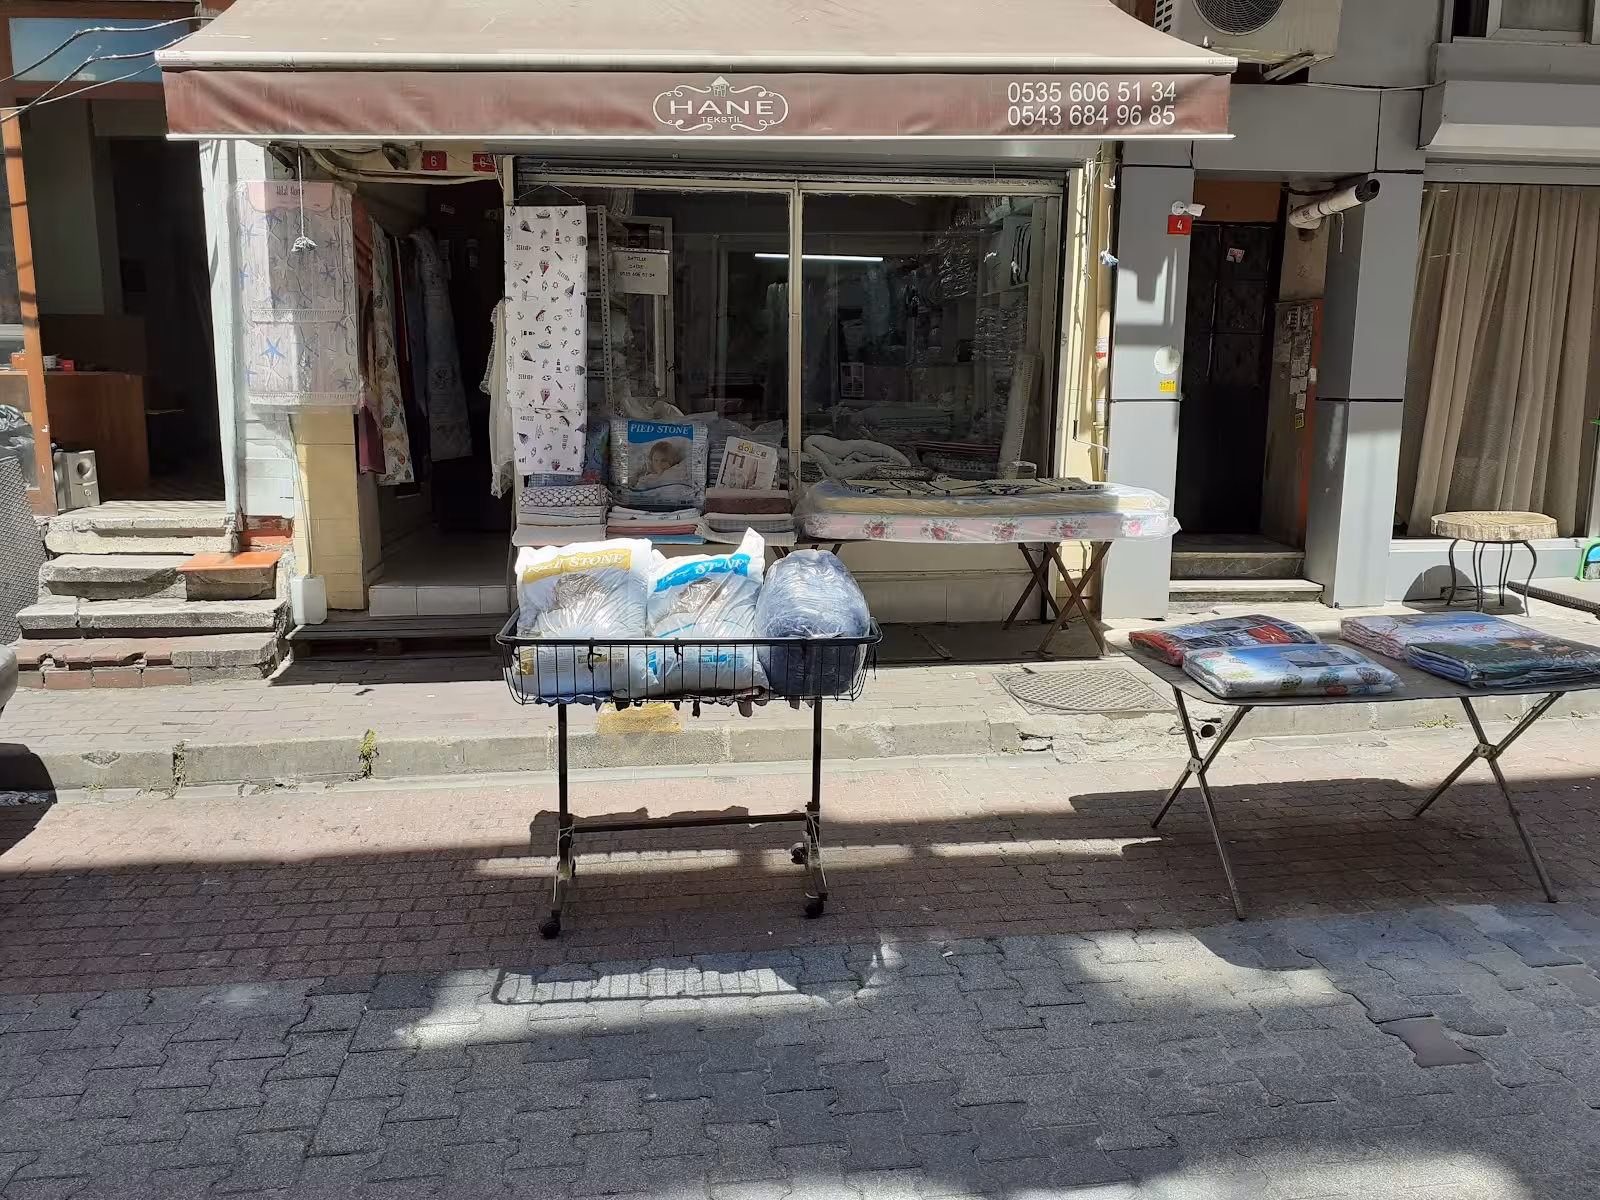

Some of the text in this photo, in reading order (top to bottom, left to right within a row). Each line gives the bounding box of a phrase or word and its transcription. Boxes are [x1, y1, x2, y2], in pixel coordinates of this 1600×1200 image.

[1007, 81, 1177, 102] 0535 606 51 34
[670, 100, 774, 114] HANE
[700, 115, 743, 124] TEKSTİL
[1007, 104, 1176, 126] 0543 684 96 85
[430, 155, 437, 167] 6
[1177, 219, 1183, 230] 4
[630, 423, 689, 435] PIED STONE
[568, 553, 625, 567] STONE
